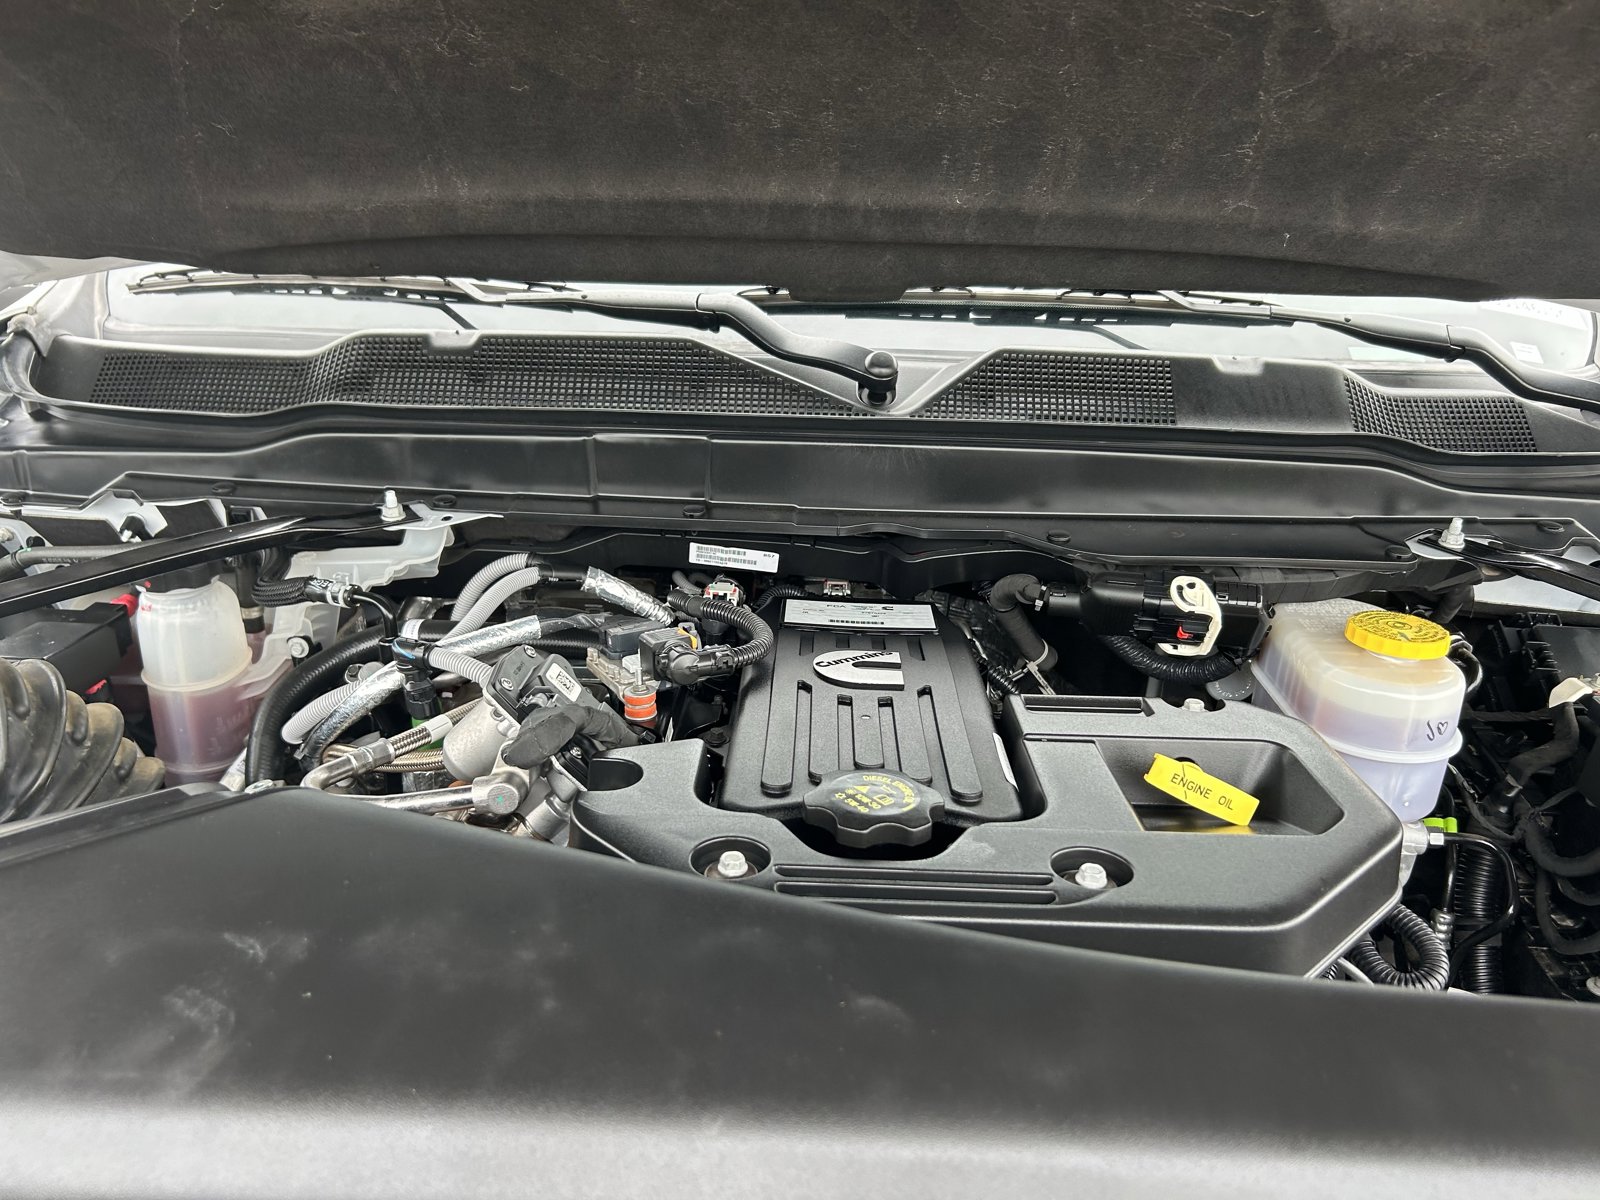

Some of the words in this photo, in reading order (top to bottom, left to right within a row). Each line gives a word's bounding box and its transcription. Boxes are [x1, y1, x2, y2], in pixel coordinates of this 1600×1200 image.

[815, 651, 894, 668] Cummins
[862, 775, 892, 785] DIESEL
[1170, 773, 1213, 799] ENGINE
[1218, 795, 1234, 811] OIL
